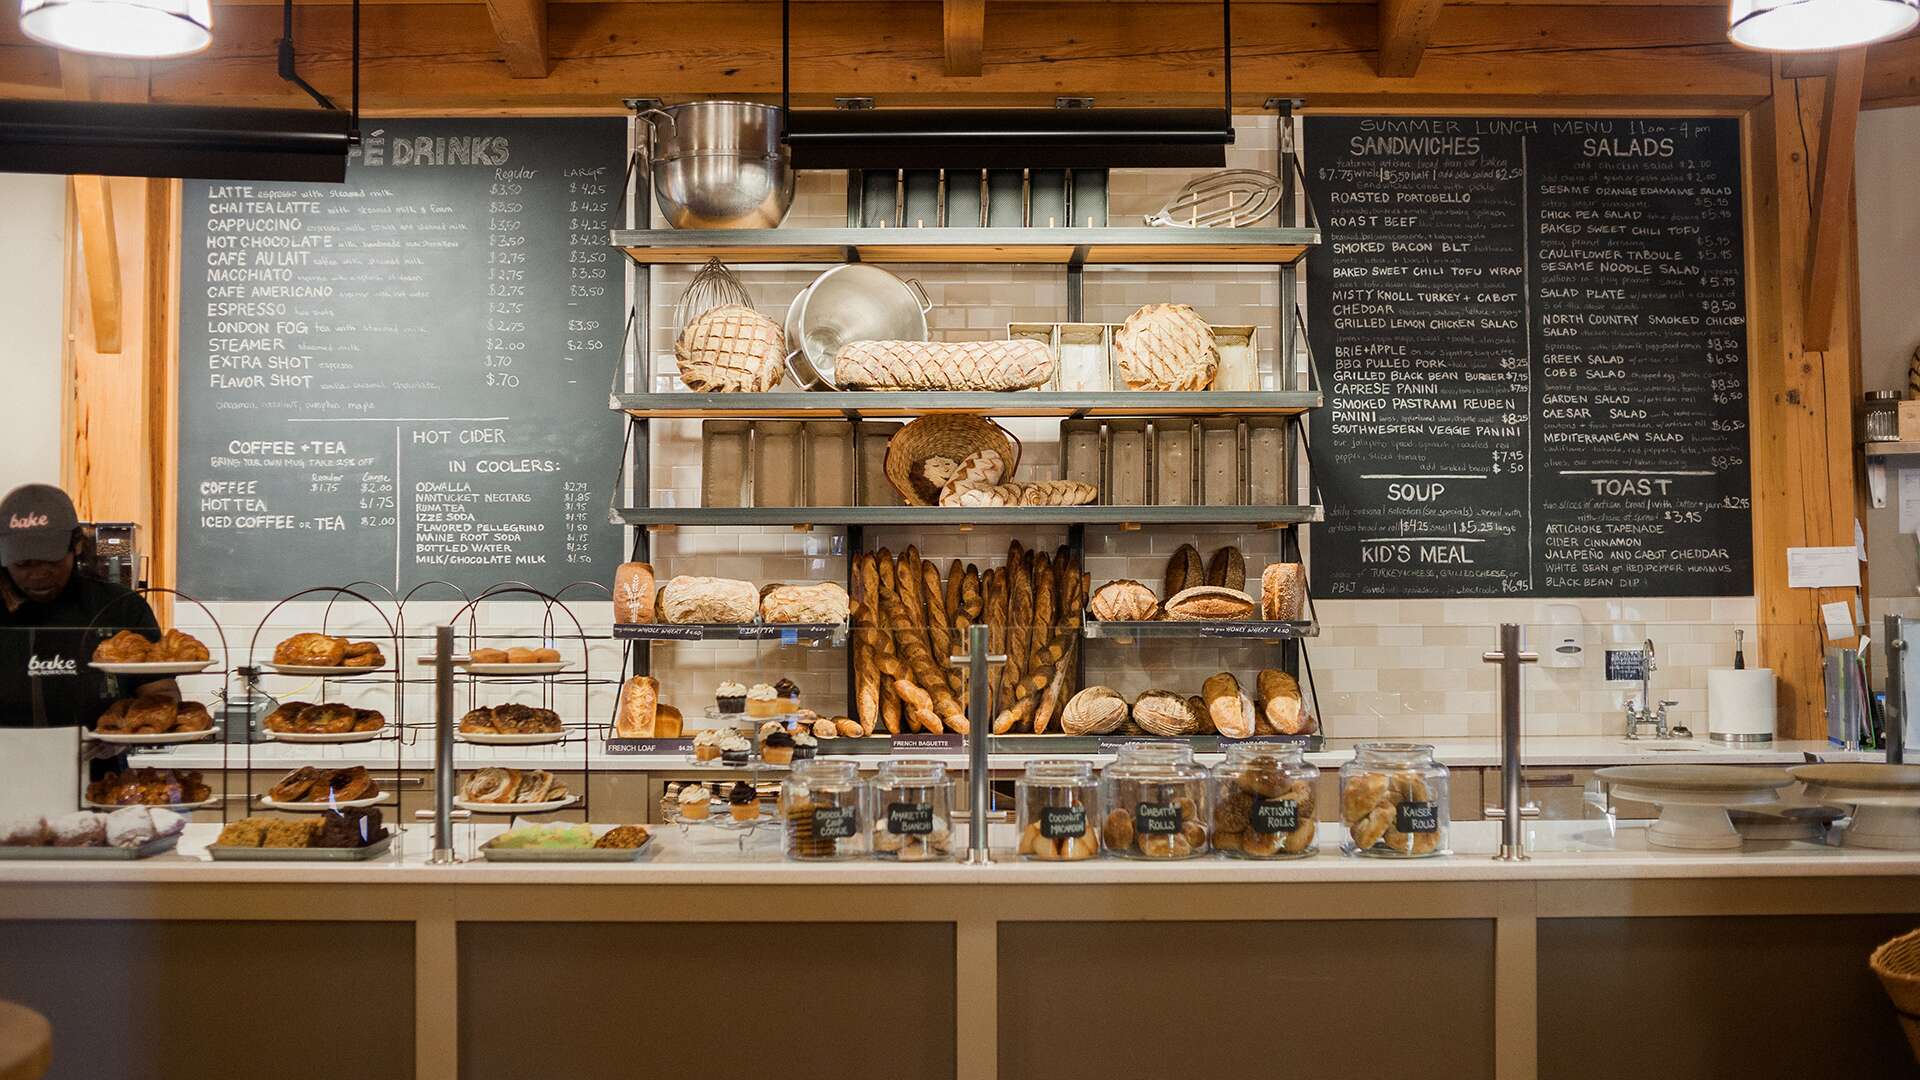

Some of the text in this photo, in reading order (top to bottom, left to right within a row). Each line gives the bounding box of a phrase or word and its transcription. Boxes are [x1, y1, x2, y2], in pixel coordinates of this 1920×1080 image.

[1360, 119, 1461, 132] SUMMER
[1476, 121, 1538, 134] LUNCH
[1552, 121, 1613, 135] MENU
[347, 129, 511, 166] FÉ DRINKS
[1350, 136, 1480, 156] SANDWICHES
[1583, 138, 1674, 157] SALADS
[495, 165, 539, 182] Regular
[208, 186, 254, 198] LATTE
[1331, 192, 1390, 203] ROASTED
[277, 202, 320, 213] LATTE
[1576, 210, 1642, 219] PEA SALAD
[207, 218, 302, 231] CAPPUCCINO
[1331, 216, 1378, 226] ROAST
[1385, 216, 1418, 227] BEEF
[1541, 224, 1627, 234] BAKED SWEET
[206, 236, 237, 248] HOT
[241, 236, 333, 248] CHOCOLATE
[1333, 243, 1385, 253] SMOKED
[1392, 243, 1432, 251] BACON
[1442, 243, 1470, 252] BLT
[255, 251, 274, 265] AU
[278, 251, 311, 265] LAIT
[1539, 249, 1623, 260] CAULIFLOWER
[207, 268, 293, 281] MACCHIATO
[1333, 267, 1523, 278] BAKED SWEET TOFU WRAP
[1540, 262, 1700, 275] SESAME NOODLE SALAD
[251, 286, 333, 297] AMERICANO
[1332, 289, 1517, 302] MISTY TURKEY CABOT
[1540, 289, 1625, 299] SALAD PLATE
[207, 303, 286, 316] ESPRESSO
[1333, 304, 1394, 316] CHEDDAR
[1335, 318, 1518, 329] GRILLED LEMON CHICKEN SALAD
[1543, 314, 1700, 325] NORTH SMOKED
[208, 321, 308, 334] LONDON FOG
[1543, 328, 1577, 336] SALAD
[208, 338, 285, 352] STEAMER
[487, 338, 603, 350] $2.00 $2.50
[209, 355, 312, 369] EXTRA SHOT
[1335, 358, 1446, 369] BBQ PULLED PORK
[1543, 354, 1624, 364] GREEK SALAD
[1333, 370, 1458, 380] GRILLED BLACK BEAN
[1586, 370, 1626, 379] SALAD
[270, 374, 313, 389] SHOT
[1334, 383, 1390, 394] CAPRESE
[1397, 384, 1438, 394] PANINI
[1332, 398, 1515, 410] SMOKED PASTRAMI REUBEN
[1543, 394, 1630, 404] GARDEN SALAD
[1332, 411, 1376, 422] PANINI
[1543, 408, 1647, 419] CAESAR SALAD
[1332, 424, 1520, 436] SOUTHWESTERN PANINI
[413, 429, 506, 444] HOT CIDER
[1544, 432, 1684, 443] MEDITERRANEAN SALAD
[229, 440, 295, 455] COFFEE
[449, 460, 466, 473] IN
[200, 480, 258, 494] COFFEE
[1387, 483, 1445, 501] SOUP
[1592, 479, 1672, 496] TOAST
[201, 499, 268, 512] HOT TEA
[9, 512, 49, 528] bake
[201, 516, 231, 528] ICED
[235, 515, 295, 529] COFFEE
[313, 515, 346, 530] TEA
[446, 513, 476, 521] SODA
[416, 524, 472, 532] FLAVORED
[1546, 523, 1664, 534] ARTICHOKE TAPENADE
[416, 533, 521, 542] MAINE ROOT SODA
[1546, 537, 1579, 546] CIDER
[471, 544, 512, 552] WATER
[1545, 548, 1729, 560] JALAPEÑO AND CHEDDAR
[515, 554, 546, 563] MILK
[1362, 546, 1474, 563] KID'S MEAL
[28, 654, 77, 670] bake
[608, 744, 636, 752] FRENCH
[637, 744, 656, 752] LOAF
[1257, 806, 1296, 817] ARTISAN
[1148, 819, 1176, 831] ROLLS
[1267, 817, 1296, 828] ROLLS
[1412, 818, 1437, 830] ROLLS
